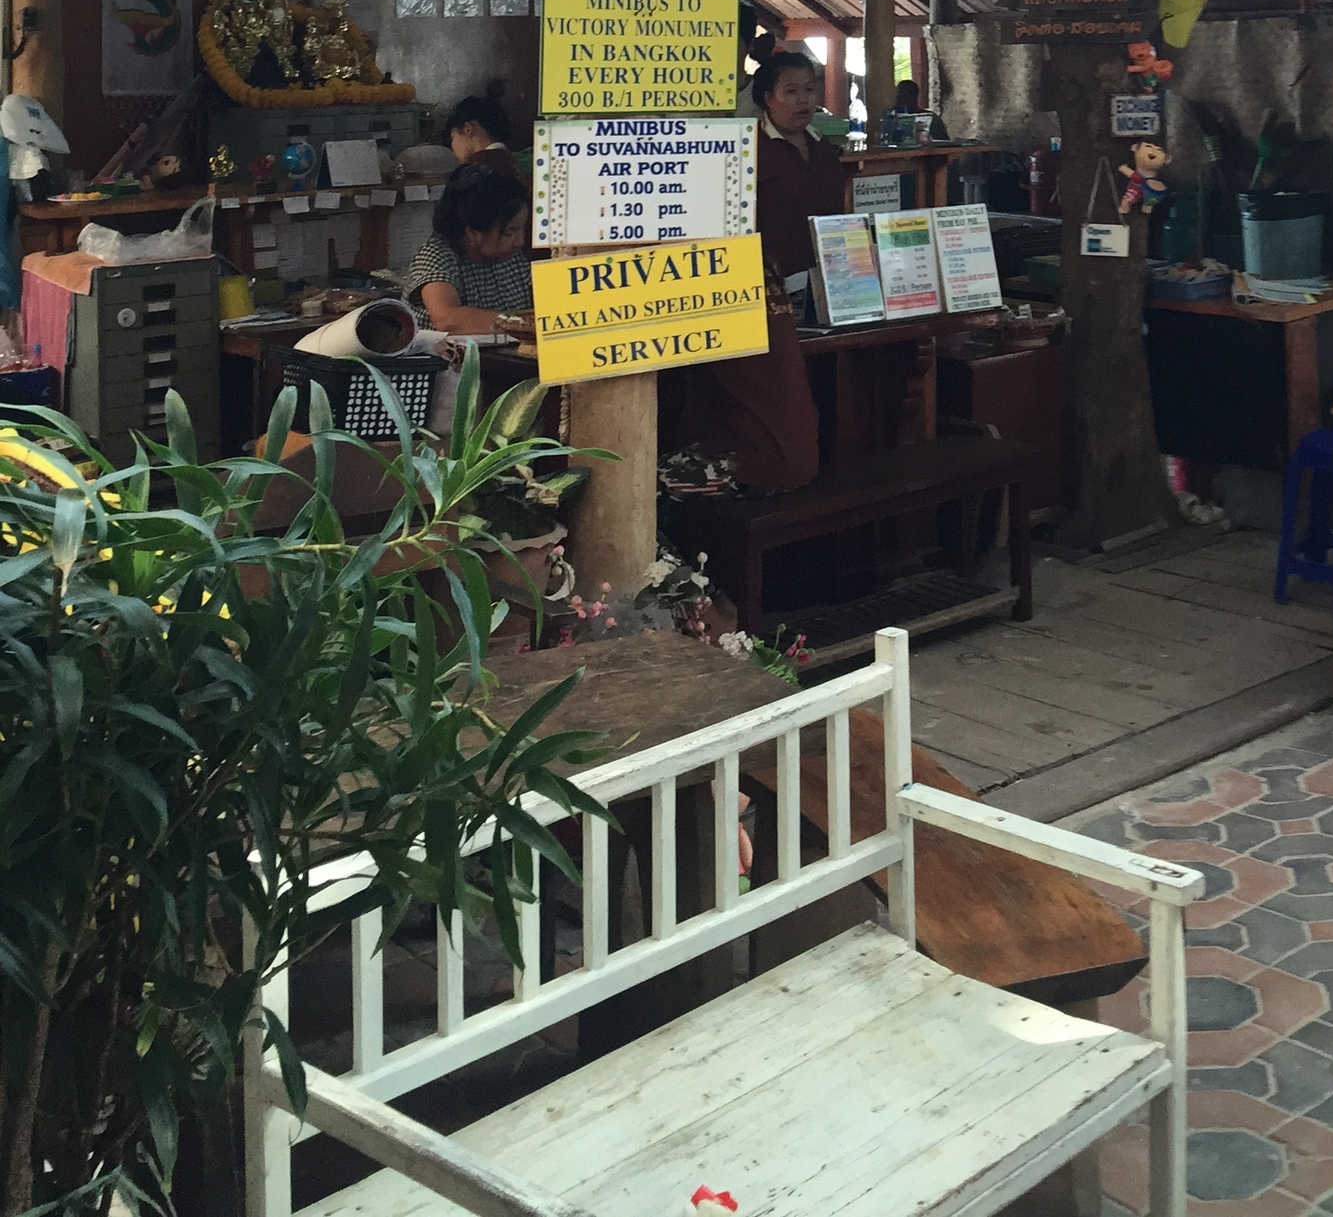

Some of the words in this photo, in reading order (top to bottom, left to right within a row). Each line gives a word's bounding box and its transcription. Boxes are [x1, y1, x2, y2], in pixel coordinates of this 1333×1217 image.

[547, 18, 629, 37] VICTORY
[635, 20, 737, 38] MONUMENT
[570, 45, 594, 62] IN
[603, 44, 712, 62] BANGKOK
[568, 67, 644, 85] EVERY
[652, 67, 714, 85] HOUR
[558, 91, 594, 109] 300
[641, 90, 720, 108] PERSON.
[595, 120, 687, 137] MINIBUS
[555, 142, 581, 157] TO
[586, 139, 736, 157] SUVANNABHUMI
[599, 161, 633, 176] AIR
[637, 161, 689, 176] PORT
[610, 181, 654, 195] 10.00
[658, 183, 688, 195] am.
[610, 203, 643, 217] 1.30
[658, 205, 688, 220] pm.
[609, 225, 644, 240] 5.00
[657, 227, 687, 241] pm.
[568, 246, 731, 297] PRIVATE
[537, 310, 589, 333] TAXI
[595, 303, 637, 325] AND
[643, 294, 705, 320] SPEED
[711, 285, 764, 308] BOAT
[592, 328, 723, 368] SERVICE
